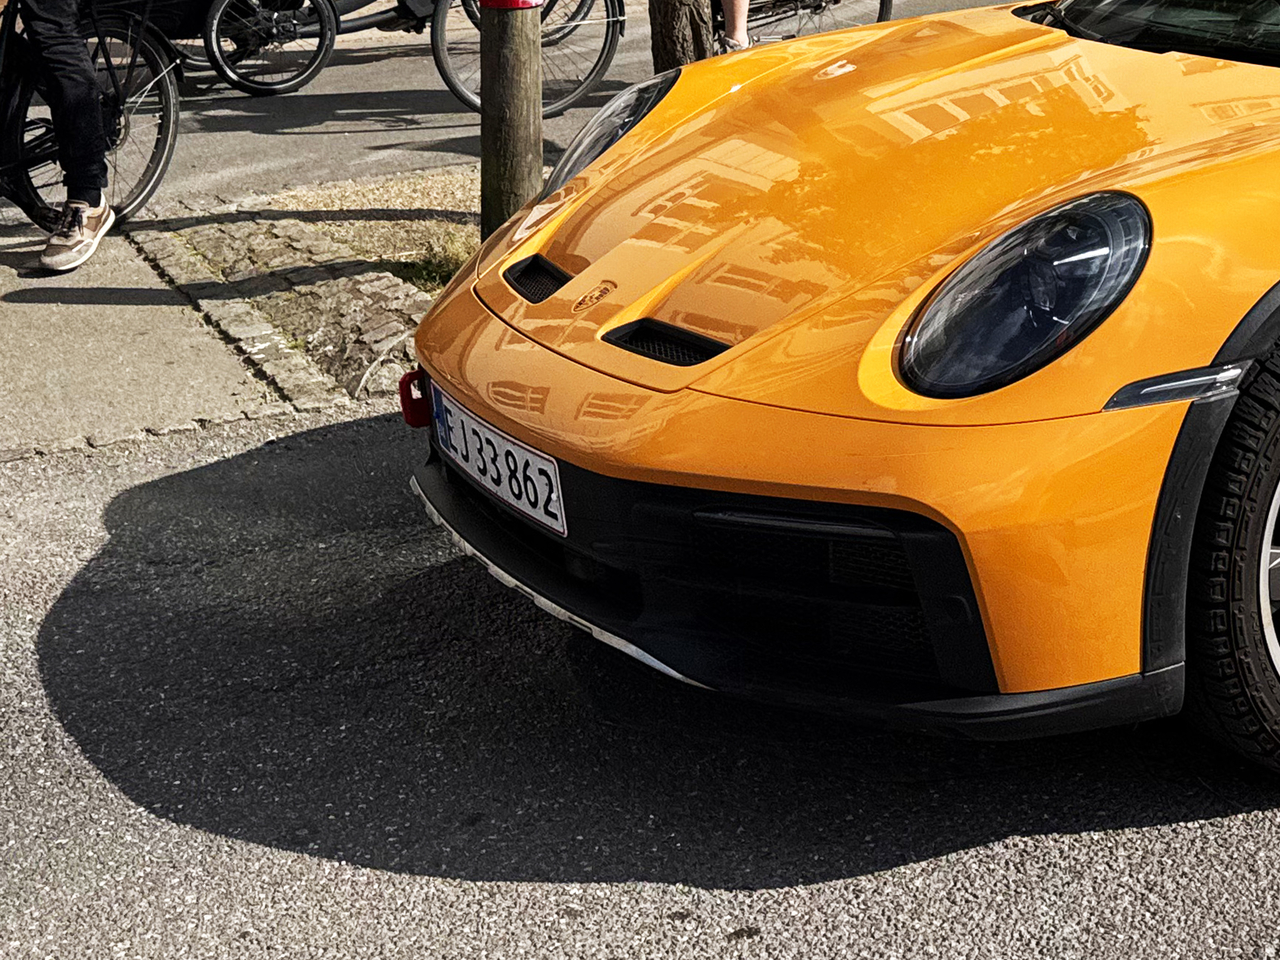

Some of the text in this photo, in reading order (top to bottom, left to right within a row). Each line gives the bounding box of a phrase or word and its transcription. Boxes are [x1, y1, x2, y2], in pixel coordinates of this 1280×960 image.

[444, 403, 559, 522] EJ 33 862
